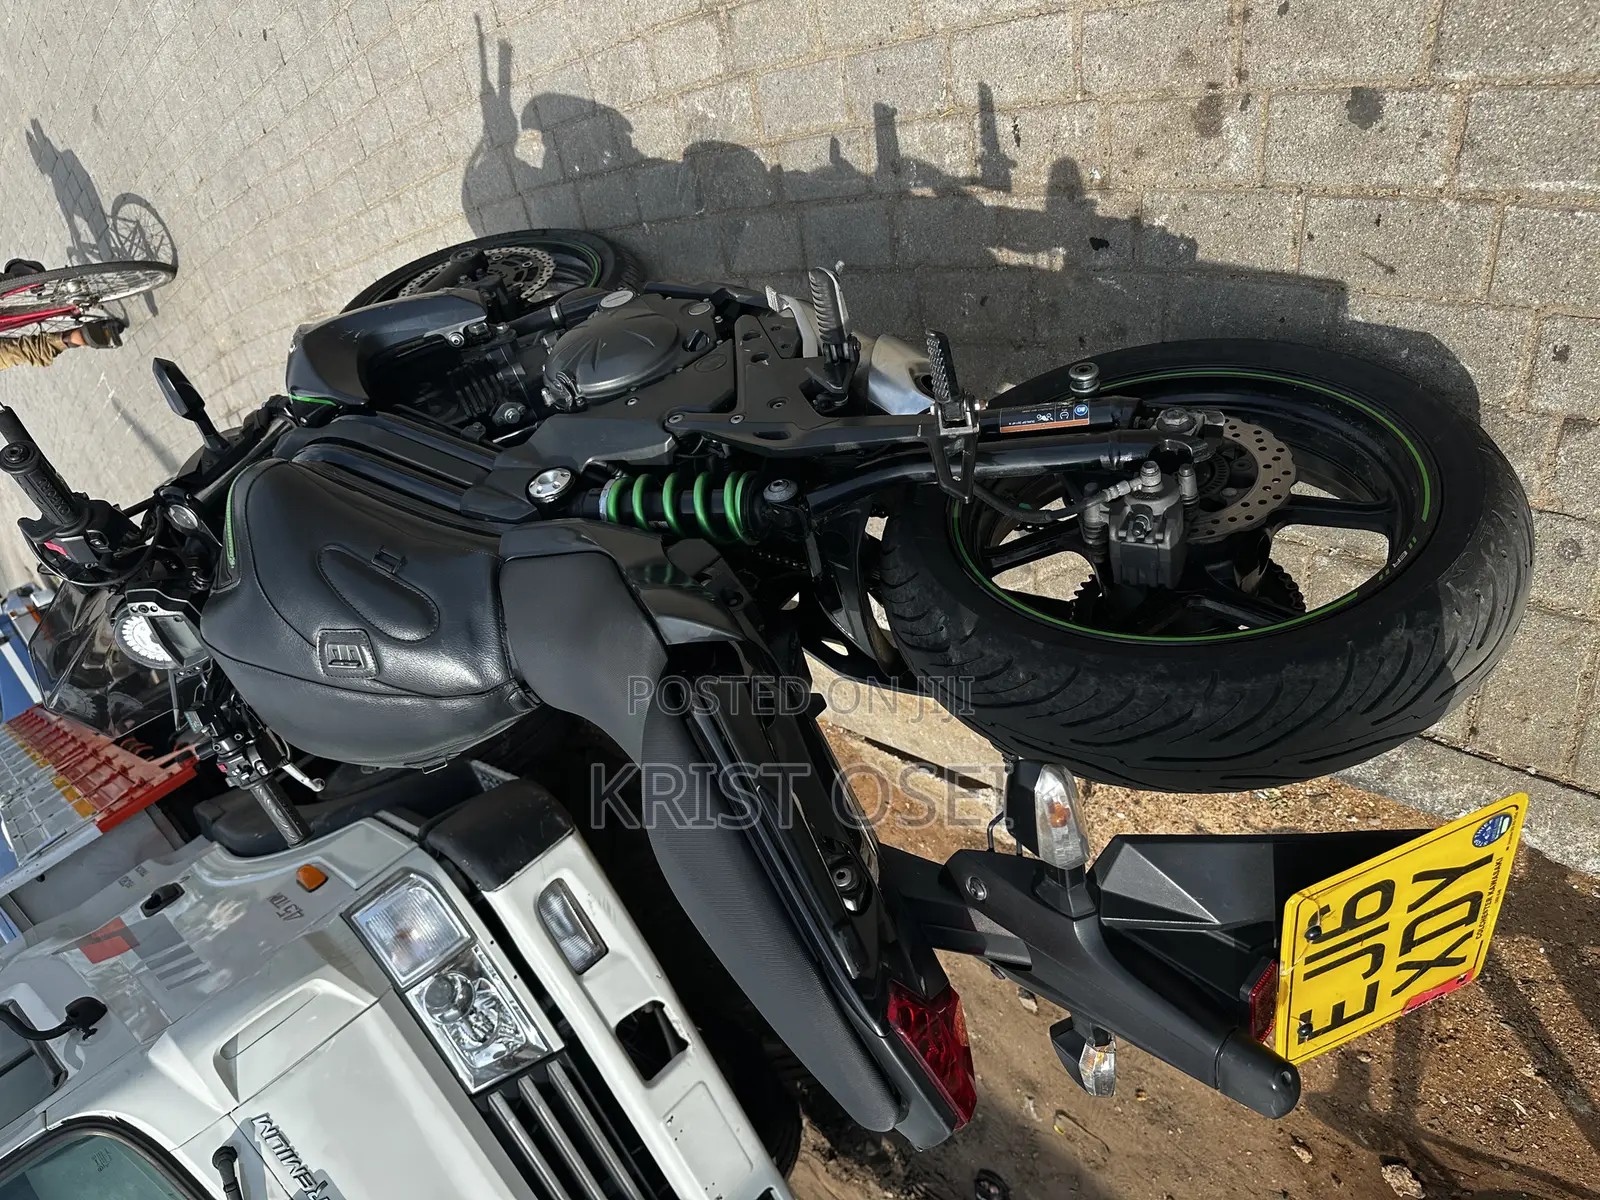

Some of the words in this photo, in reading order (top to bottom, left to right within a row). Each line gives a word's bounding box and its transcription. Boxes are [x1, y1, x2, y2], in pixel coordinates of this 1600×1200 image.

[1391, 853, 1494, 997] XDY
[1487, 857, 1503, 897] KAWASAKI
[1297, 879, 1396, 1045] EJ16
[250, 1113, 331, 1200] REMIUM
